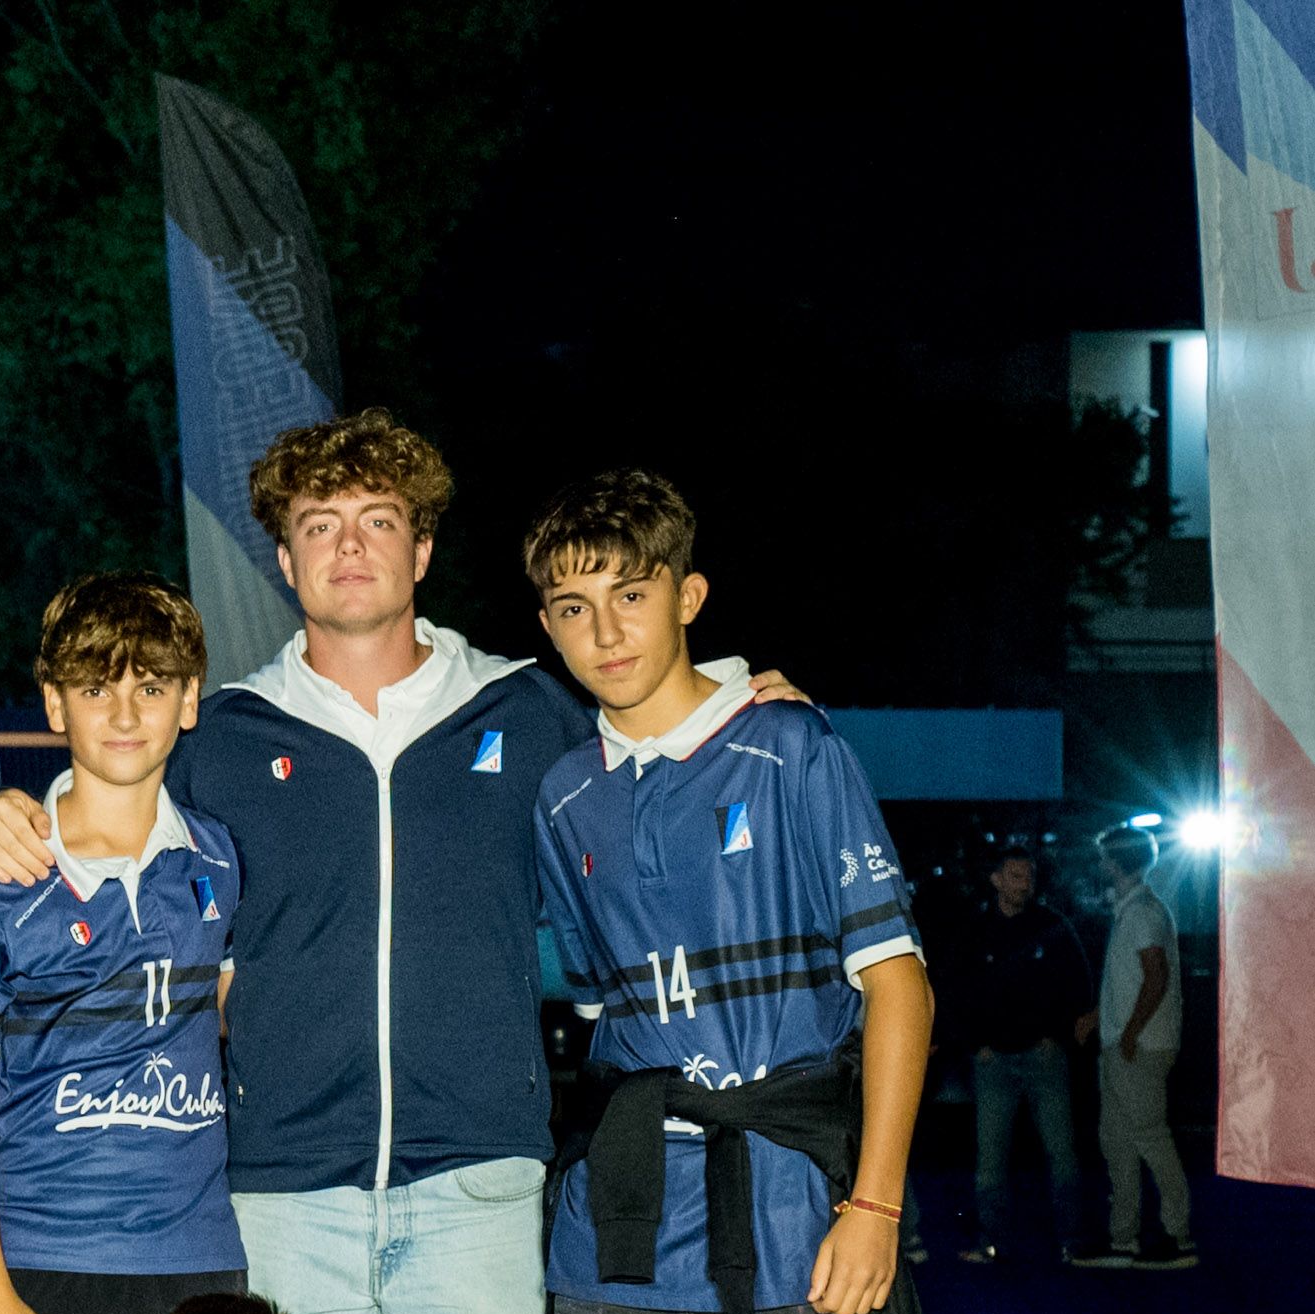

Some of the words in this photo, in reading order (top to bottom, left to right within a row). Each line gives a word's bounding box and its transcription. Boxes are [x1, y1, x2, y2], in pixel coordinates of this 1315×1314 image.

[142, 958, 173, 1027] 11
[647, 945, 697, 1024] 14
[55, 1071, 163, 1130] Enjoy
[167, 1072, 227, 1117] Cuba
